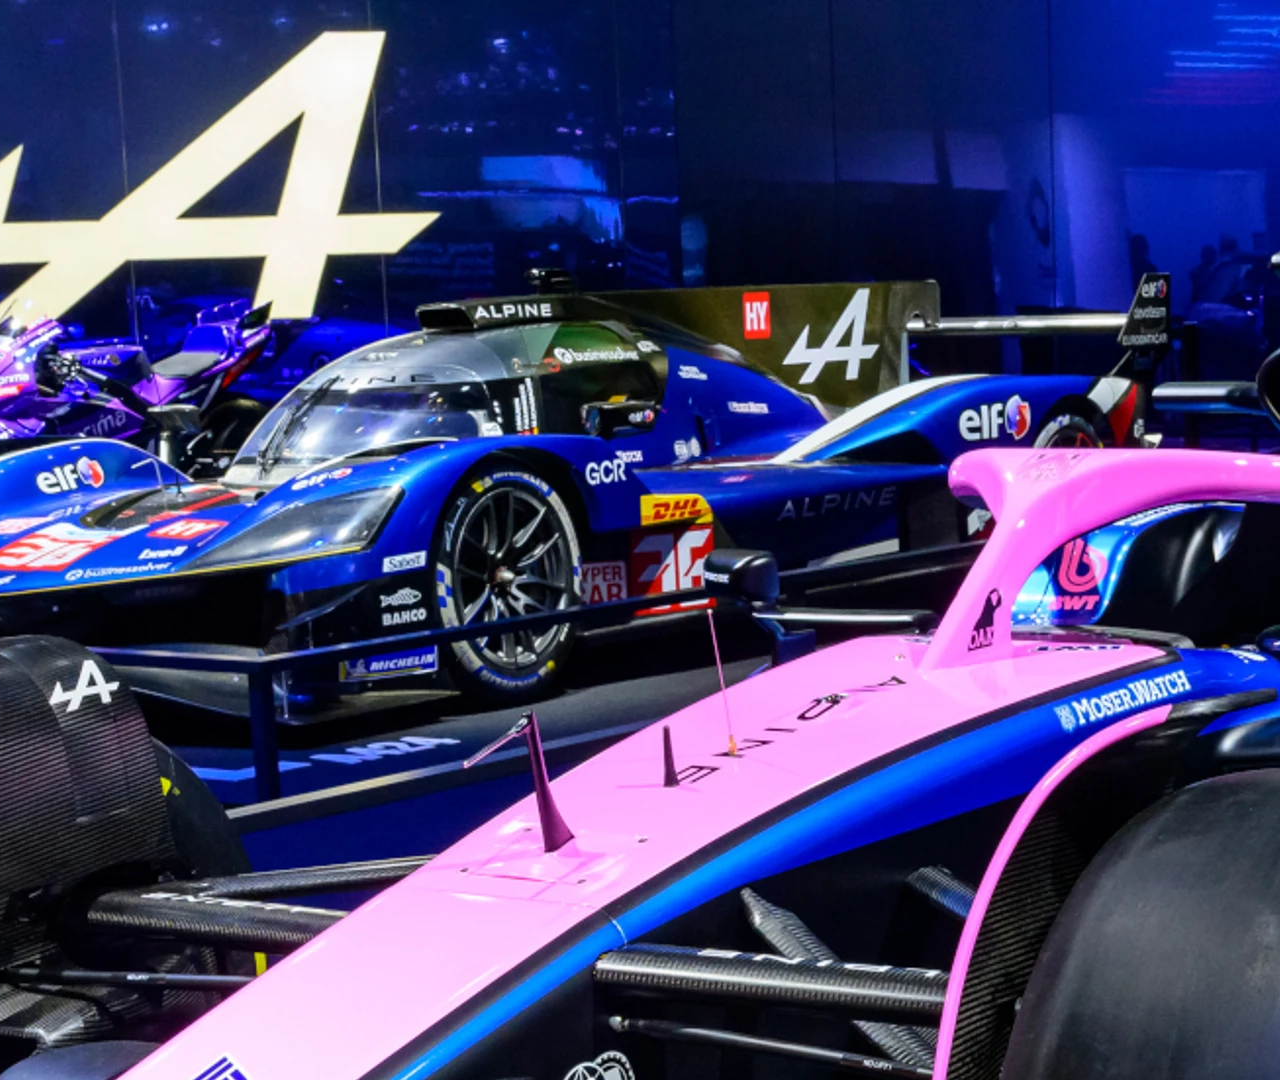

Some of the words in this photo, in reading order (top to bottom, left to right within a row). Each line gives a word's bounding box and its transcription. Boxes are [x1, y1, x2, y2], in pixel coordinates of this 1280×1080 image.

[475, 303, 553, 319] ALPINE
[745, 301, 768, 331] HY
[81, 409, 127, 438] rima
[958, 402, 1005, 441] elf
[36, 463, 78, 494] elf
[585, 458, 627, 486] GCR
[652, 498, 702, 521] DHL
[777, 486, 896, 522] ALPINE
[581, 564, 623, 582] YPER
[581, 583, 623, 603] AR
[1047, 594, 1100, 611] BWT
[381, 608, 427, 627] BAHCO
[369, 651, 436, 672] MICHELIN
